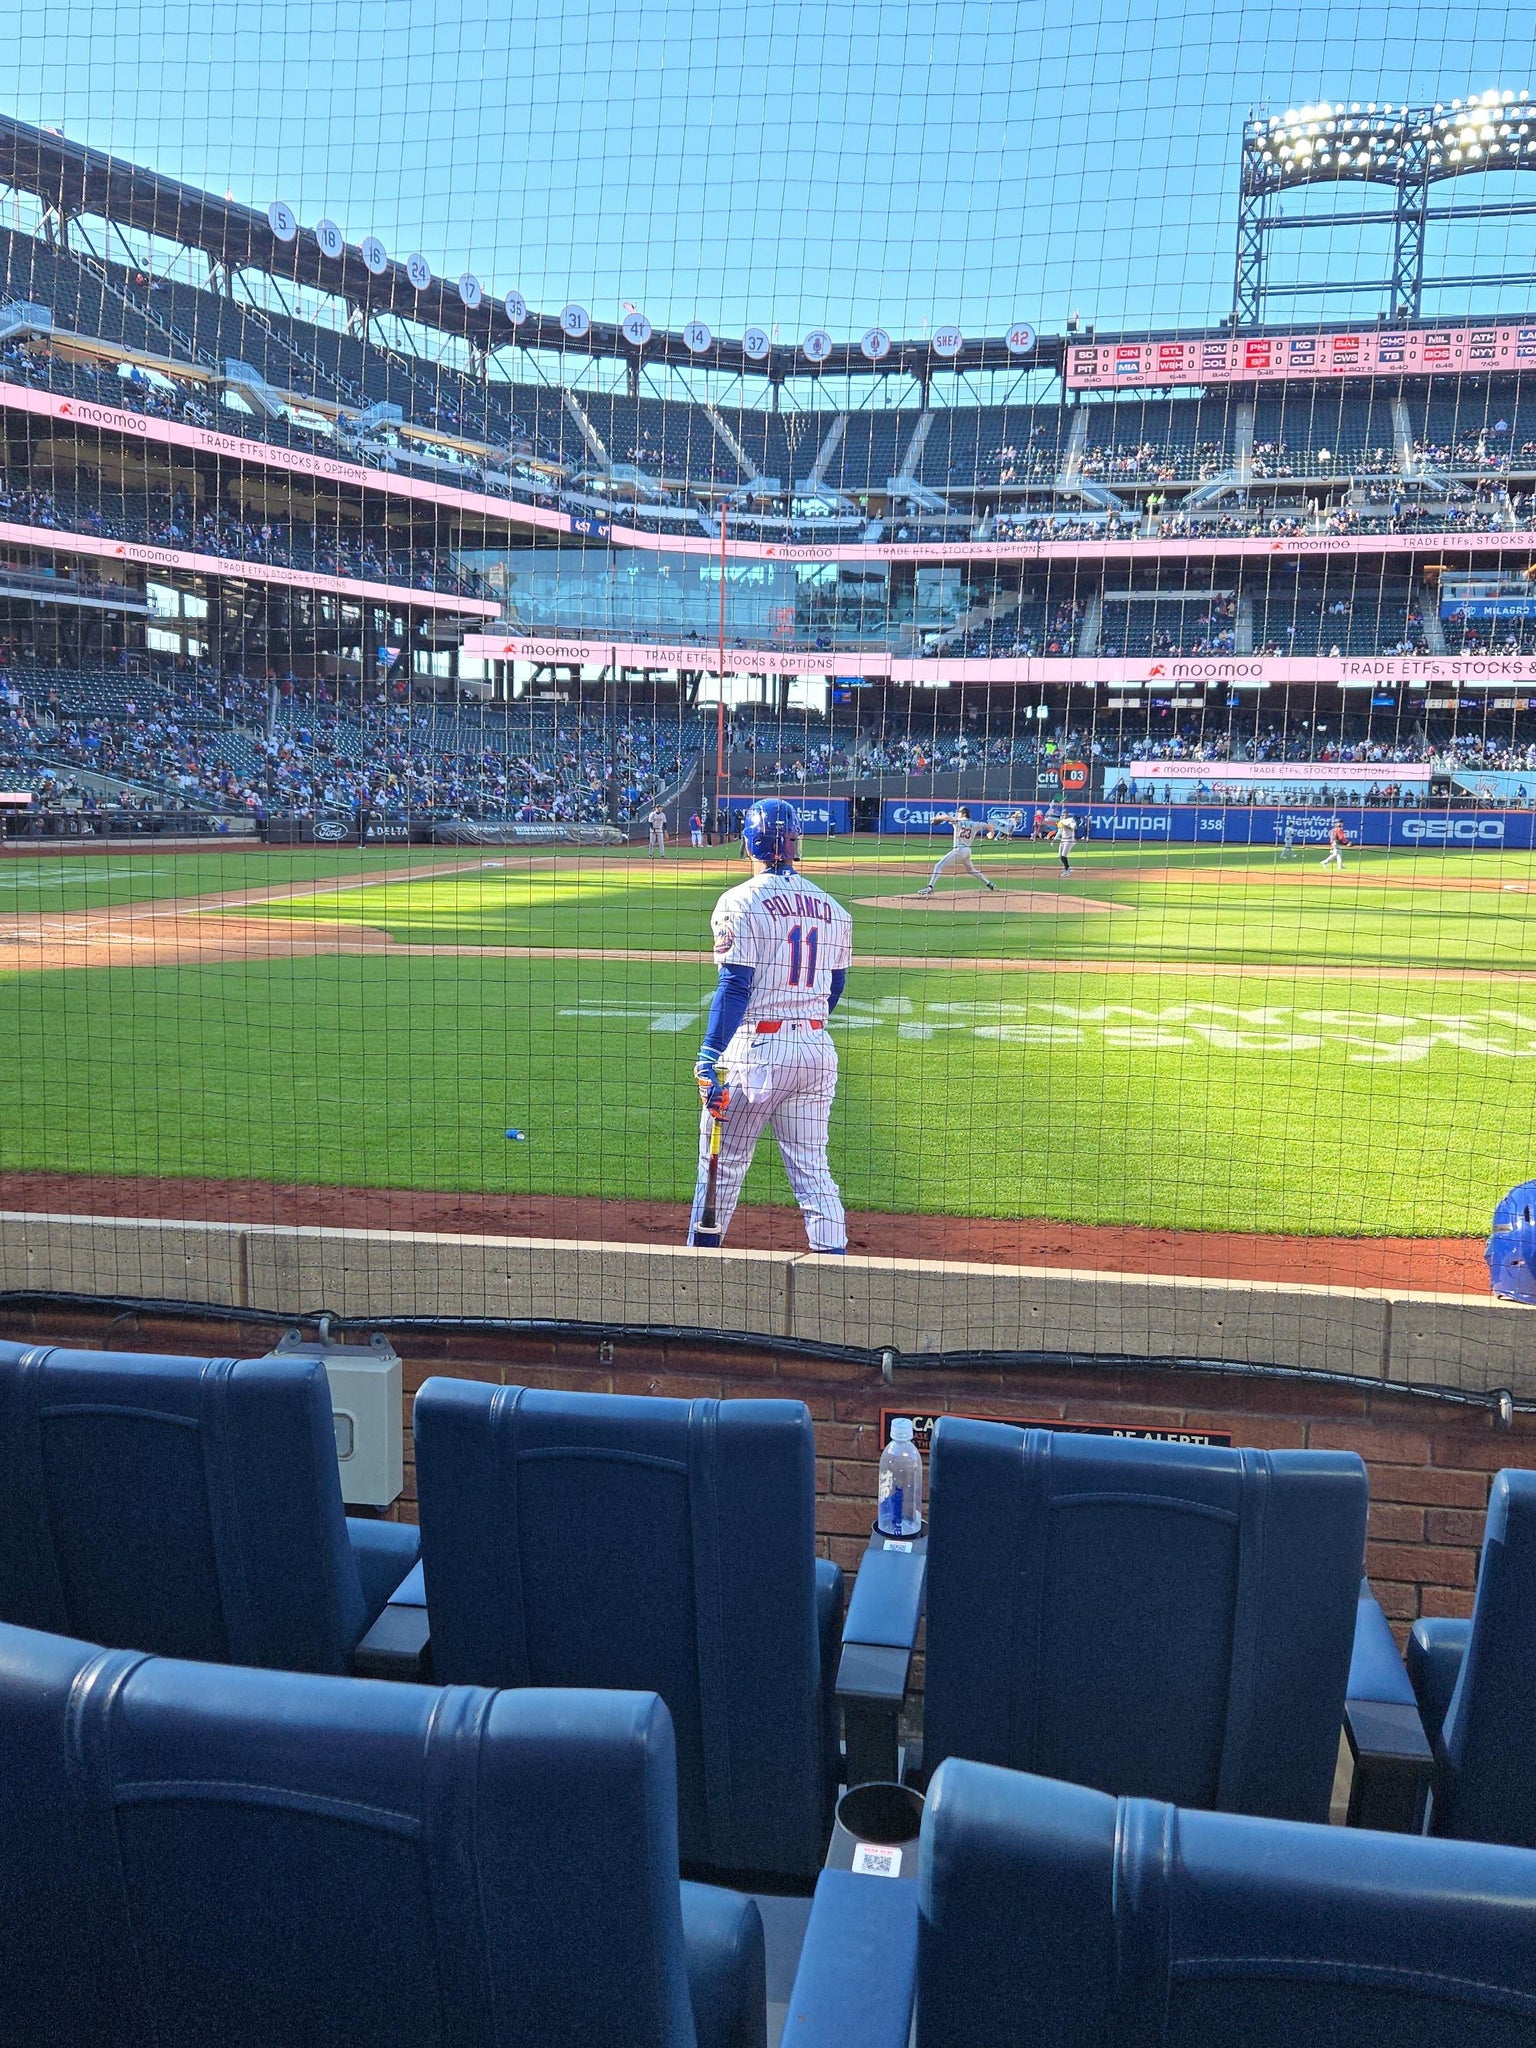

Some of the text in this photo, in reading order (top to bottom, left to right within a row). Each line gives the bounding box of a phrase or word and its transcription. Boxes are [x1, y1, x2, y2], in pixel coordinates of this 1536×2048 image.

[278, 213, 287, 230] 5
[323, 229, 335, 248] 18
[369, 247, 381, 264] 16
[411, 263, 426, 280] 24
[465, 282, 476, 299] 17
[569, 313, 581, 328] 31
[631, 321, 644, 336] 41
[692, 330, 704, 345] 14
[1011, 331, 1029, 346] 42
[1411, 336, 1417, 344] 0
[1428, 336, 1448, 344] MIL
[1456, 334, 1463, 343] 0
[1472, 334, 1495, 342] ATH
[1503, 332, 1509, 340] 0
[749, 337, 764, 352] 37
[937, 336, 960, 347] SHEA
[1276, 342, 1283, 350] 0
[1103, 350, 1109, 358] 0
[1146, 348, 1152, 356] 0
[1161, 347, 1182, 355] STL
[1189, 346, 1195, 354] 0
[1204, 345, 1226, 353] HOU
[1425, 350, 1450, 358] BOS
[1455, 349, 1462, 357] 0
[1471, 348, 1495, 357] NYY
[1501, 347, 1508, 355] 0
[1292, 356, 1314, 364] CLE
[1334, 353, 1358, 362] CWS
[1364, 353, 1370, 361] 2
[1410, 351, 1416, 359] 0
[1102, 364, 1109, 372] 0
[1145, 362, 1151, 370] 0
[1188, 360, 1194, 368] 0
[1231, 359, 1237, 367] 0
[1078, 365, 1095, 373] PIT
[78, 406, 147, 432] moomoo
[200, 433, 236, 451] TRADE
[271, 449, 312, 468] STOCKS
[315, 460, 321, 470] &
[324, 463, 368, 481] OPTIONS
[1288, 540, 1350, 550] moomoo
[1403, 535, 1535, 546] TRADE ETFs, STOCKS &
[780, 548, 832, 557] moomoo
[877, 547, 909, 555] TRADE
[942, 546, 982, 554] STOCKS
[996, 545, 1045, 553] OPTIONS
[130, 547, 180, 564] moomoo
[219, 561, 245, 573] TRADE
[1483, 606, 1530, 615] MILAGRO
[521, 644, 590, 658] moomoo
[645, 650, 833, 669] TRADE ETFs, STOCKS & OPTIONS
[1172, 663, 1263, 677] moomoo
[1340, 661, 1536, 676] TRADE ETFs, STOCKS &
[1163, 766, 1210, 774] moomoo
[1249, 766, 1276, 774] TRADE
[1303, 767, 1339, 775] STOCKS
[1350, 767, 1390, 775] OPTIONS
[1038, 771, 1059, 784] citi
[1070, 770, 1084, 781] 03
[1090, 816, 1172, 831] HYUNDAI
[1200, 819, 1223, 830] 358
[318, 823, 342, 837] Ford
[376, 826, 409, 836] DELTA
[960, 827, 972, 839] 23
[1402, 819, 1505, 839] GEICO
[762, 893, 832, 925] POLANCO
[788, 925, 819, 988] 11
